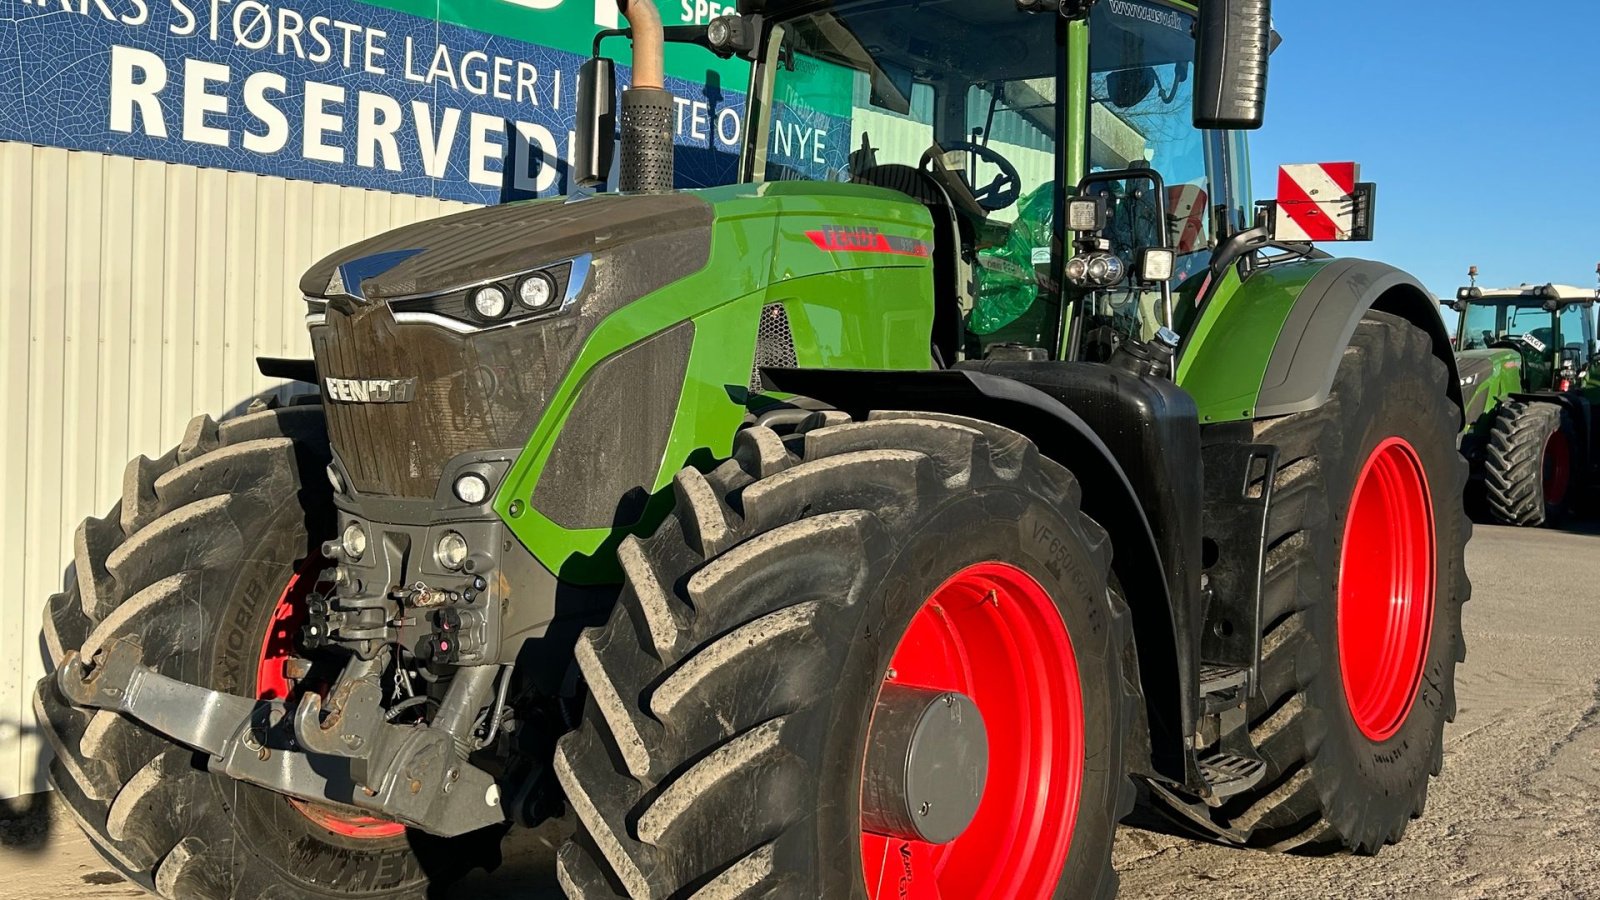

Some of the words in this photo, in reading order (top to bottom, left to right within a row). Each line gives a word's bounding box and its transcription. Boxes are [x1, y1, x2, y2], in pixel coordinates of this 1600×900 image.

[170, 0, 387, 75] STØRSTE
[404, 36, 539, 106] LAGER
[553, 69, 561, 110] I
[774, 120, 827, 164] NYE
[822, 224, 879, 247] FENDT
[1523, 333, 1543, 348] SOLGT
[325, 376, 418, 402] FENDT
